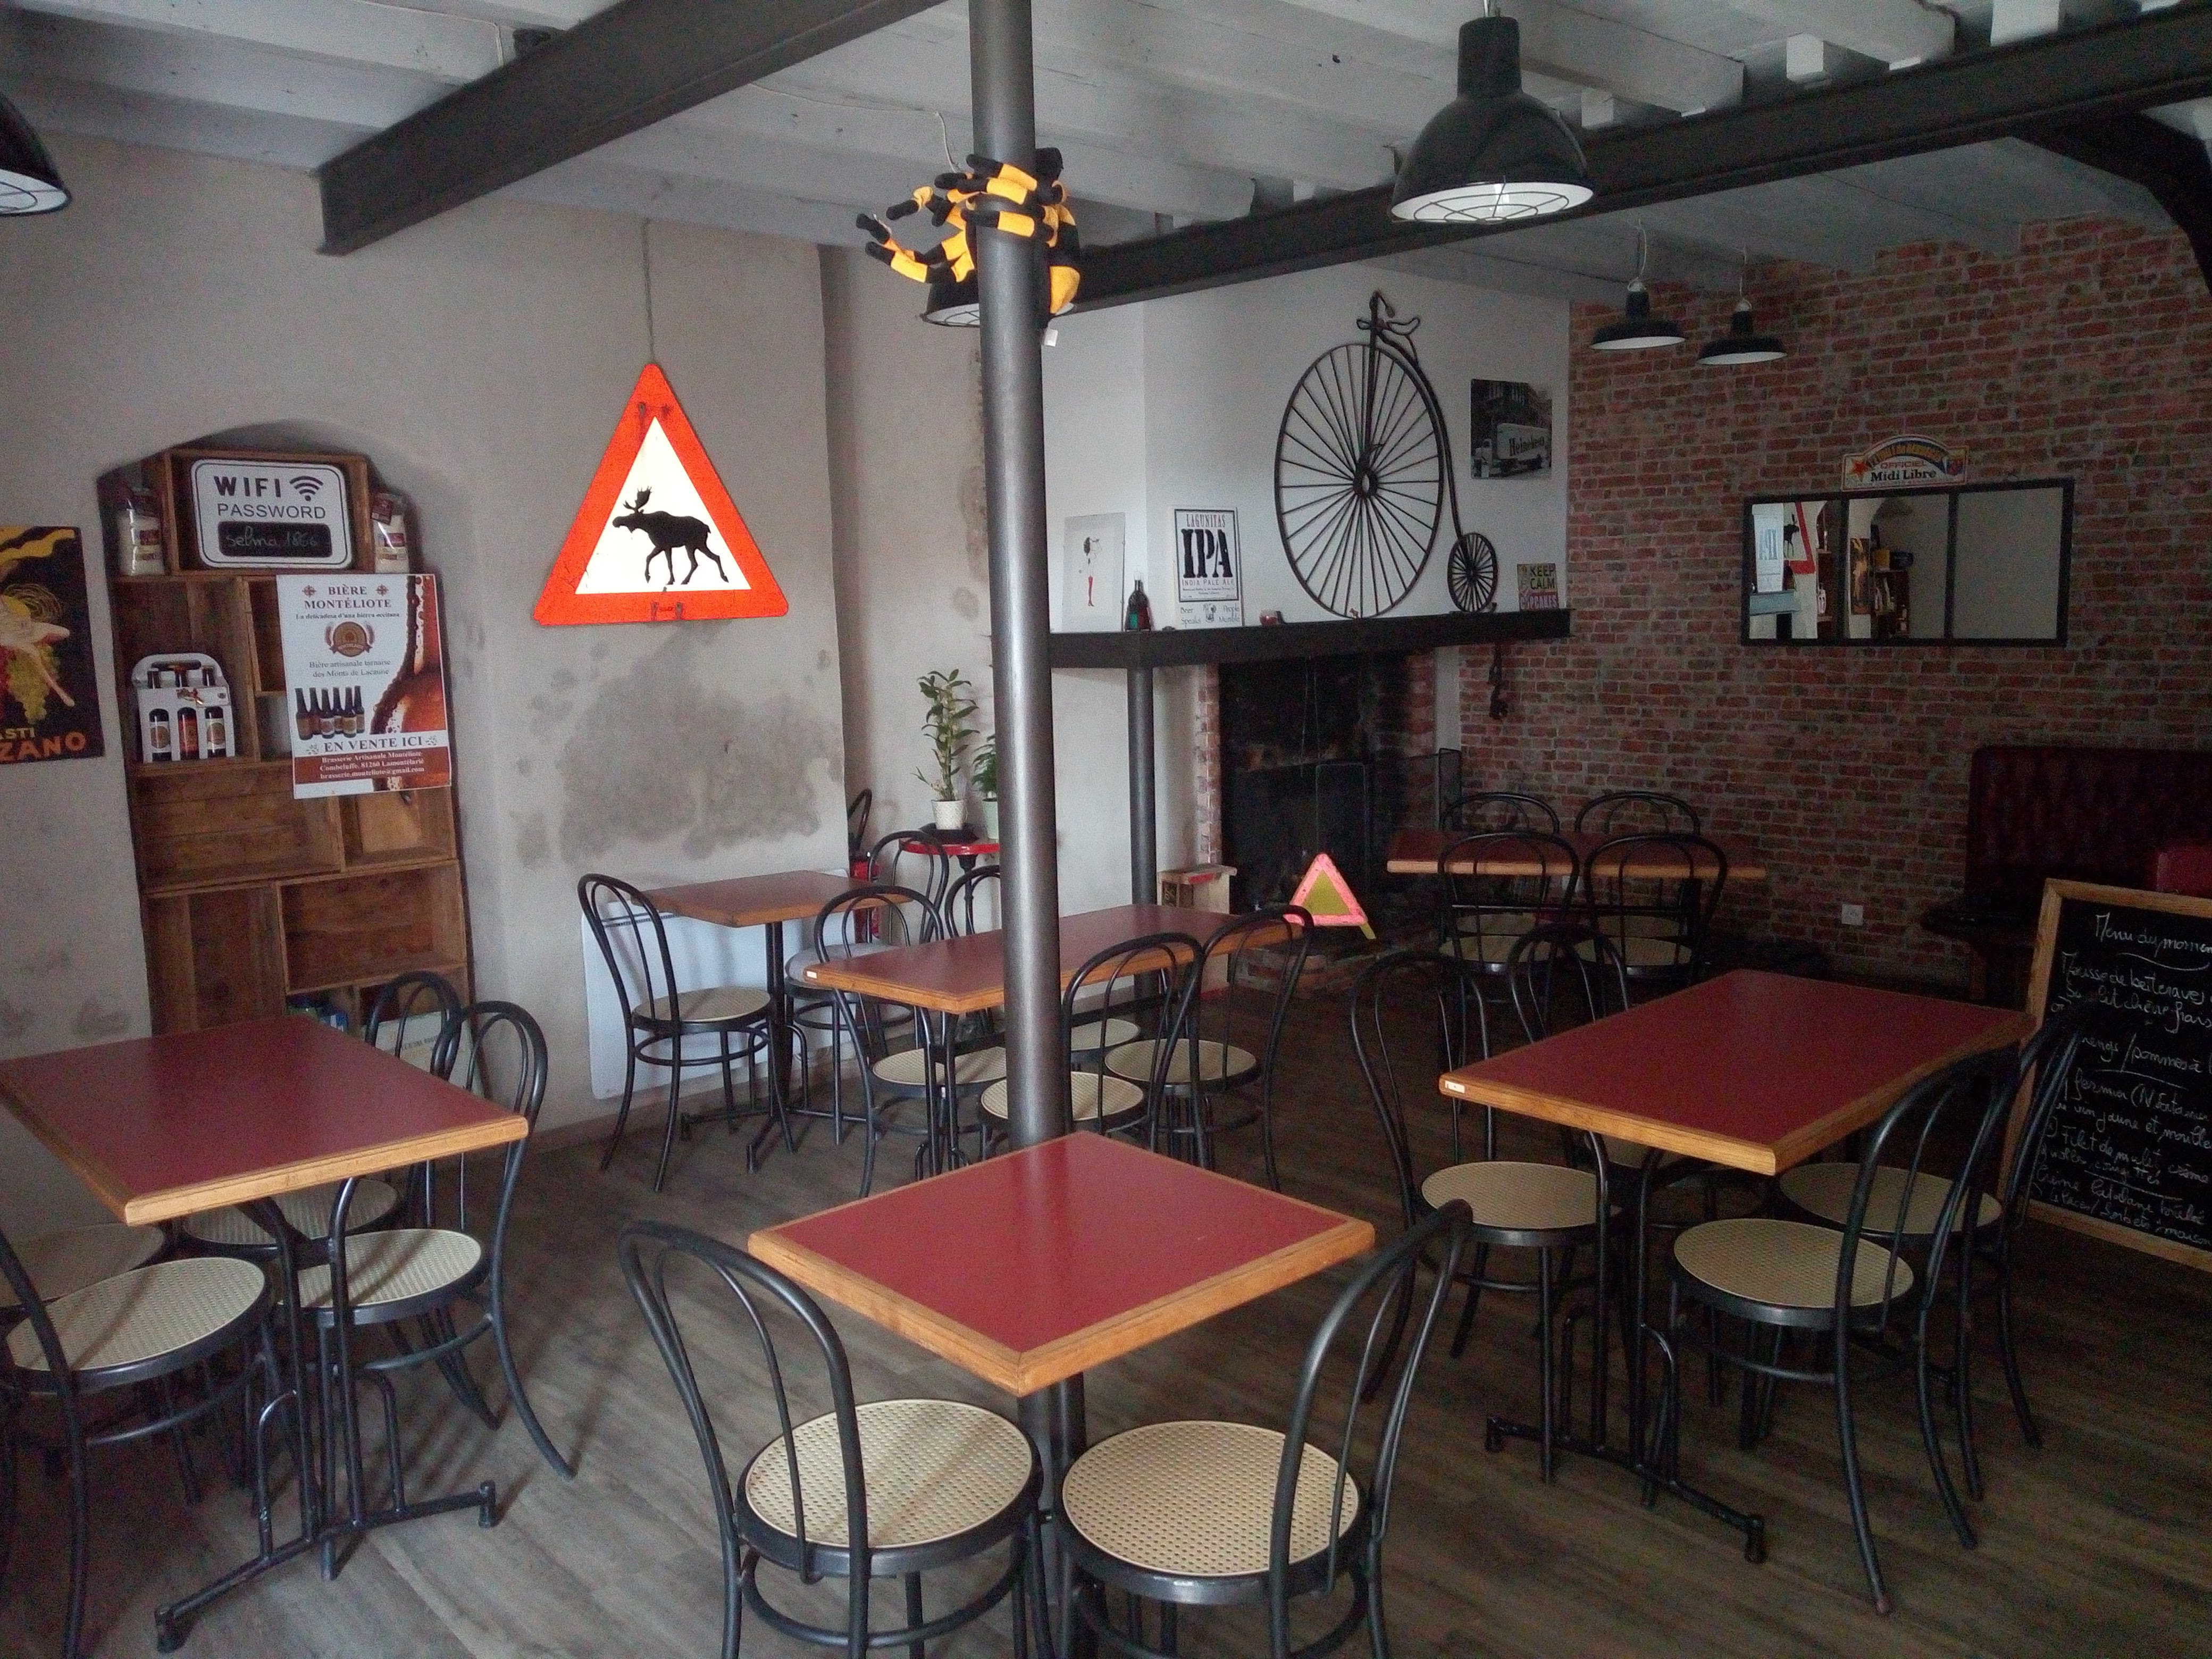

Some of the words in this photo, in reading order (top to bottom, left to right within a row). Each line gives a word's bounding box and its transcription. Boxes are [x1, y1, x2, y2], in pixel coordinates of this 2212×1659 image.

[1871, 470, 1900, 482] Midi
[1903, 469, 1937, 480] Libre
[213, 476, 281, 497] WIFI
[217, 503, 326, 519] PASSWORD
[1186, 513, 1226, 528] LAGUNITAS
[1181, 529, 1233, 579] IPA
[1530, 564, 1555, 576] KEEP
[328, 584, 367, 595] BIÈRE
[1530, 577, 1555, 590] CALM
[304, 597, 391, 609] MONTÉLIOTE
[324, 742, 344, 752] EN
[348, 738, 397, 750] VENTE
[403, 736, 423, 746] ICI
[2096, 911, 2133, 942] Menu
[2136, 927, 2157, 944] du
[2109, 968, 2128, 986] de
[2145, 1115, 2161, 1135] et
